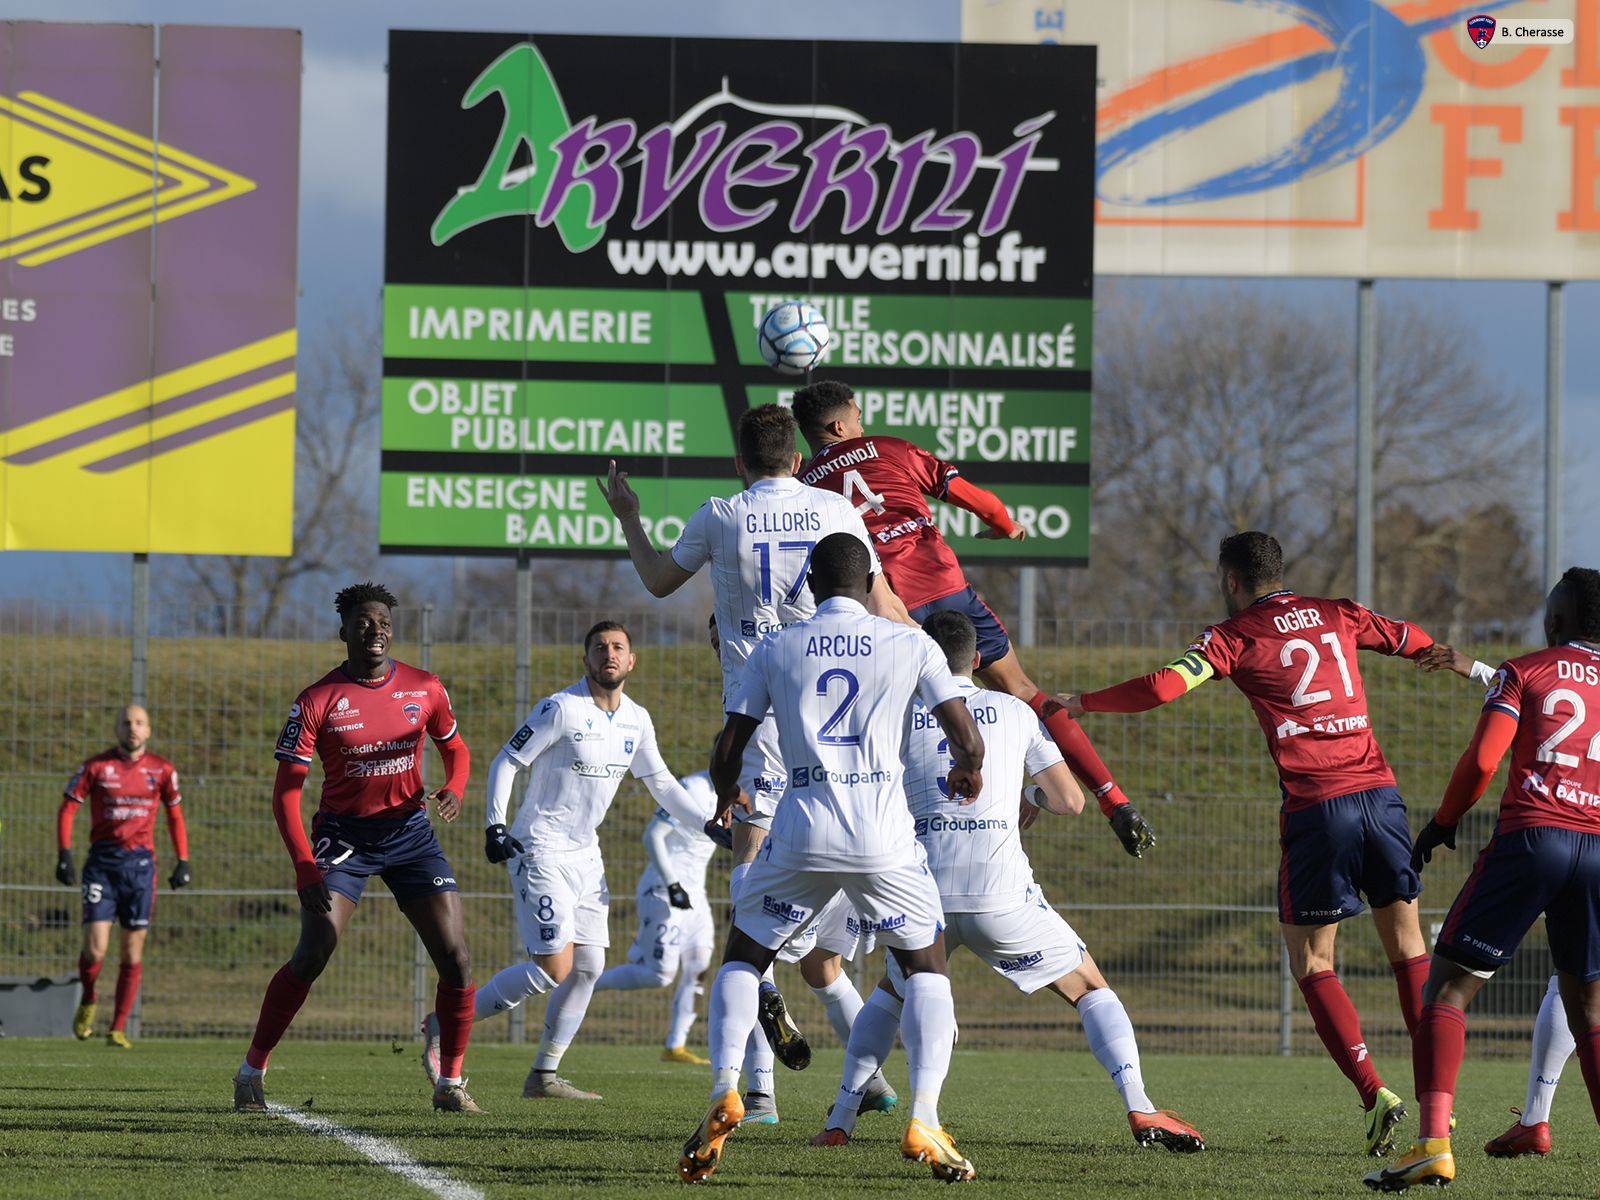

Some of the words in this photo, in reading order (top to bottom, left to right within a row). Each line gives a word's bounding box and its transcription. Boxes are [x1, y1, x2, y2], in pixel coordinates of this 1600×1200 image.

[608, 231, 1046, 282] www.arverni.fr
[0, 298, 37, 322] ES
[750, 295, 870, 331] TILE
[409, 306, 651, 344] IMPRIMERIE
[408, 380, 518, 416] OBJET
[777, 389, 1005, 428] EIPEMENT
[451, 417, 686, 455] PUBLICITAIRE
[936, 427, 1077, 463] SPORTIF
[406, 478, 587, 511] ENSEIGNE
[843, 469, 886, 516] 4
[752, 540, 817, 607] 17
[805, 635, 873, 657] ARCUS
[1279, 631, 1354, 708] 21
[1557, 659, 1600, 686] DOS
[816, 668, 860, 746] 2
[914, 706, 998, 731] BERD
[334, 723, 364, 732] PATRICK
[340, 743, 373, 755] Crédit
[366, 754, 415, 769] CLERMONT
[366, 762, 415, 777] FERRAND
[811, 765, 892, 787] Groupama
[930, 816, 1008, 834] Groupama
[315, 837, 355, 865] 27
[538, 894, 555, 921] 8
[763, 894, 805, 920] BigMat
[1310, 908, 1342, 917] PATRICK
[656, 924, 680, 945] 22
[860, 913, 906, 933] BigMat
[1000, 950, 1043, 970] BigMat
[1472, 938, 1504, 957] PATRICK
